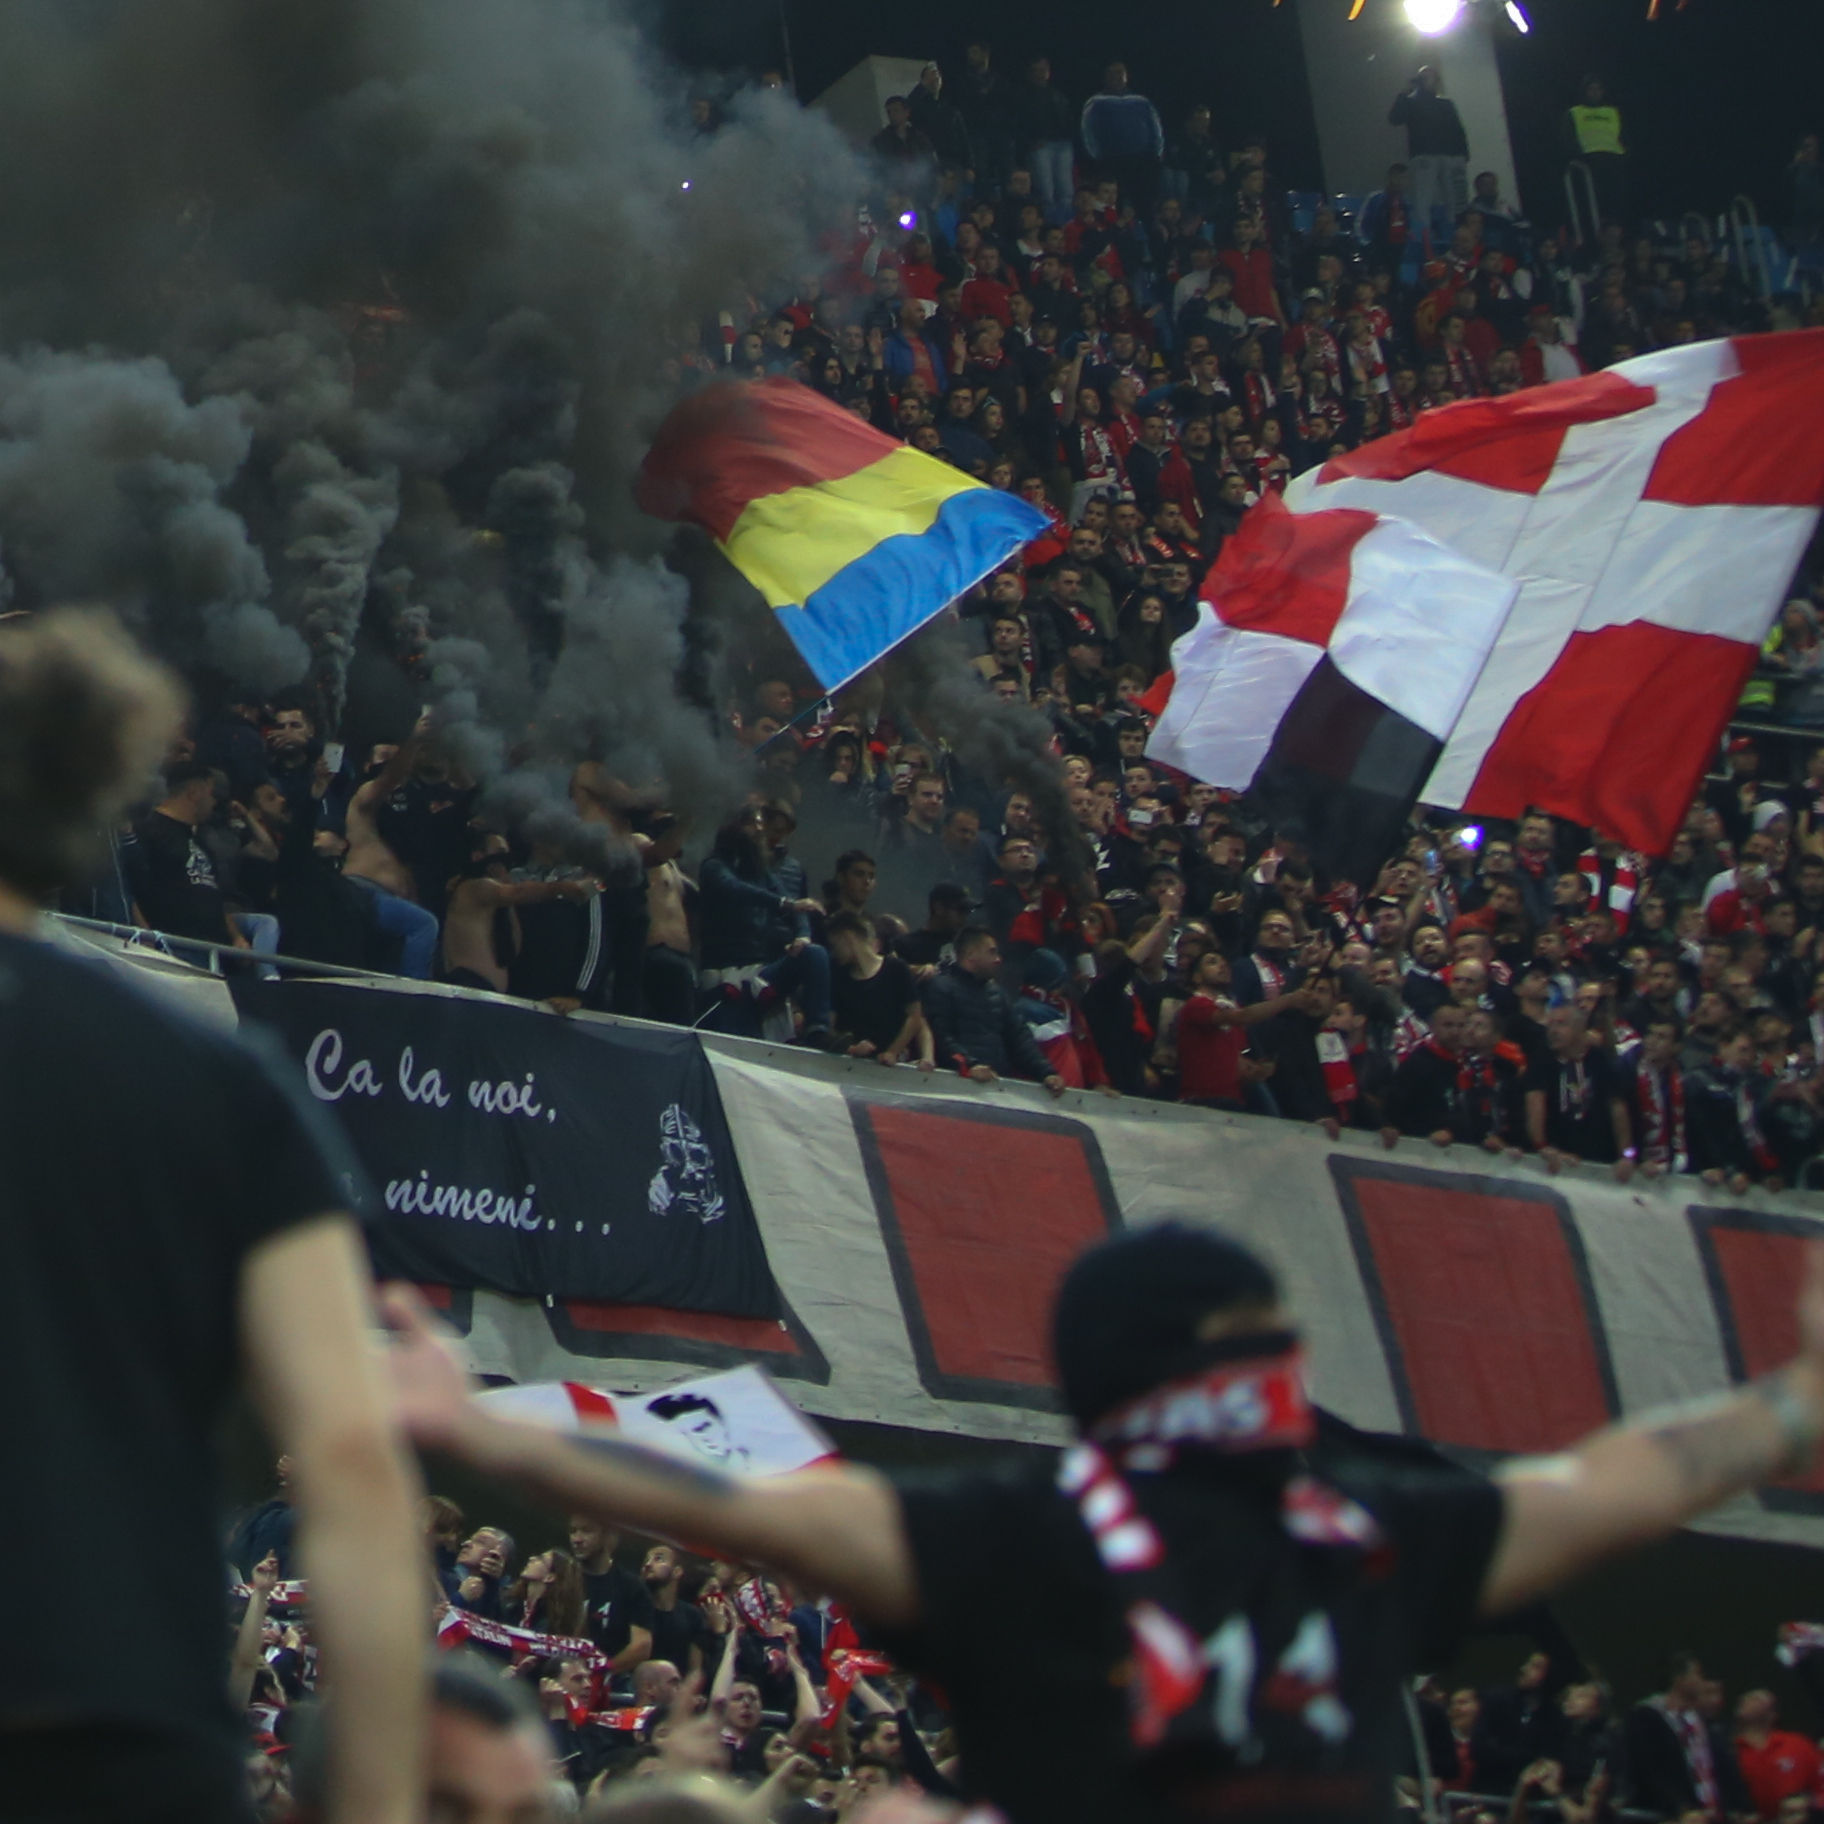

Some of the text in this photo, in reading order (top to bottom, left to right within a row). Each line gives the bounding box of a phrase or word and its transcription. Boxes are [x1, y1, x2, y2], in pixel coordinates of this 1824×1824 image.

[305, 1028, 556, 1124] Ca la noi,
[384, 1169, 611, 1236] nimeni...
